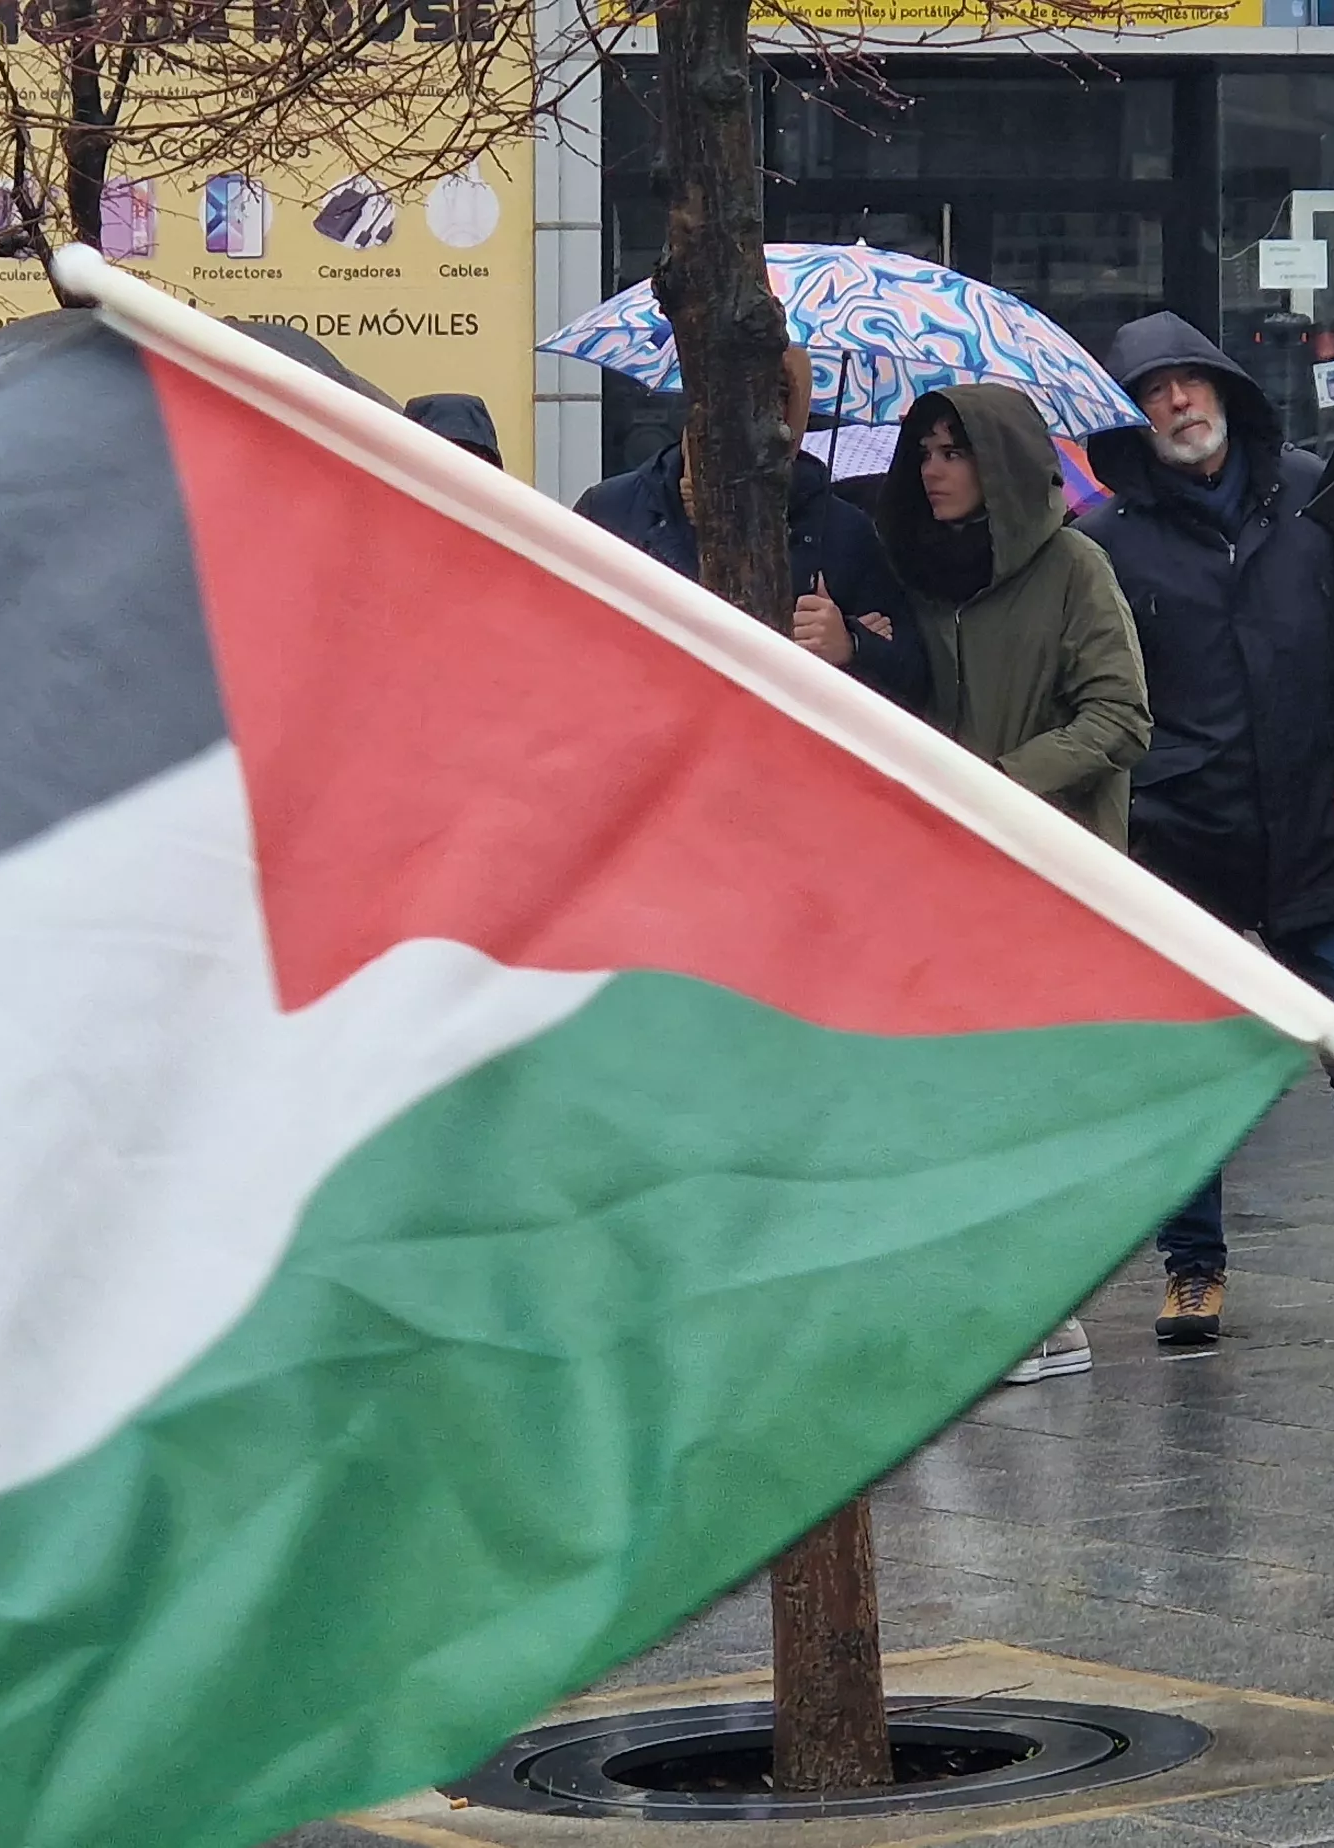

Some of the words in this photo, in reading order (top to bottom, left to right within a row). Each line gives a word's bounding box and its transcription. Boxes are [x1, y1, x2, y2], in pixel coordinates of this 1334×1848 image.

[815, 6, 832, 18] de
[192, 265, 283, 280] Protectores
[317, 264, 402, 281] Cargadores
[438, 263, 490, 278] Cables
[316, 314, 351, 336] DE
[358, 308, 479, 336] MÓVILES
